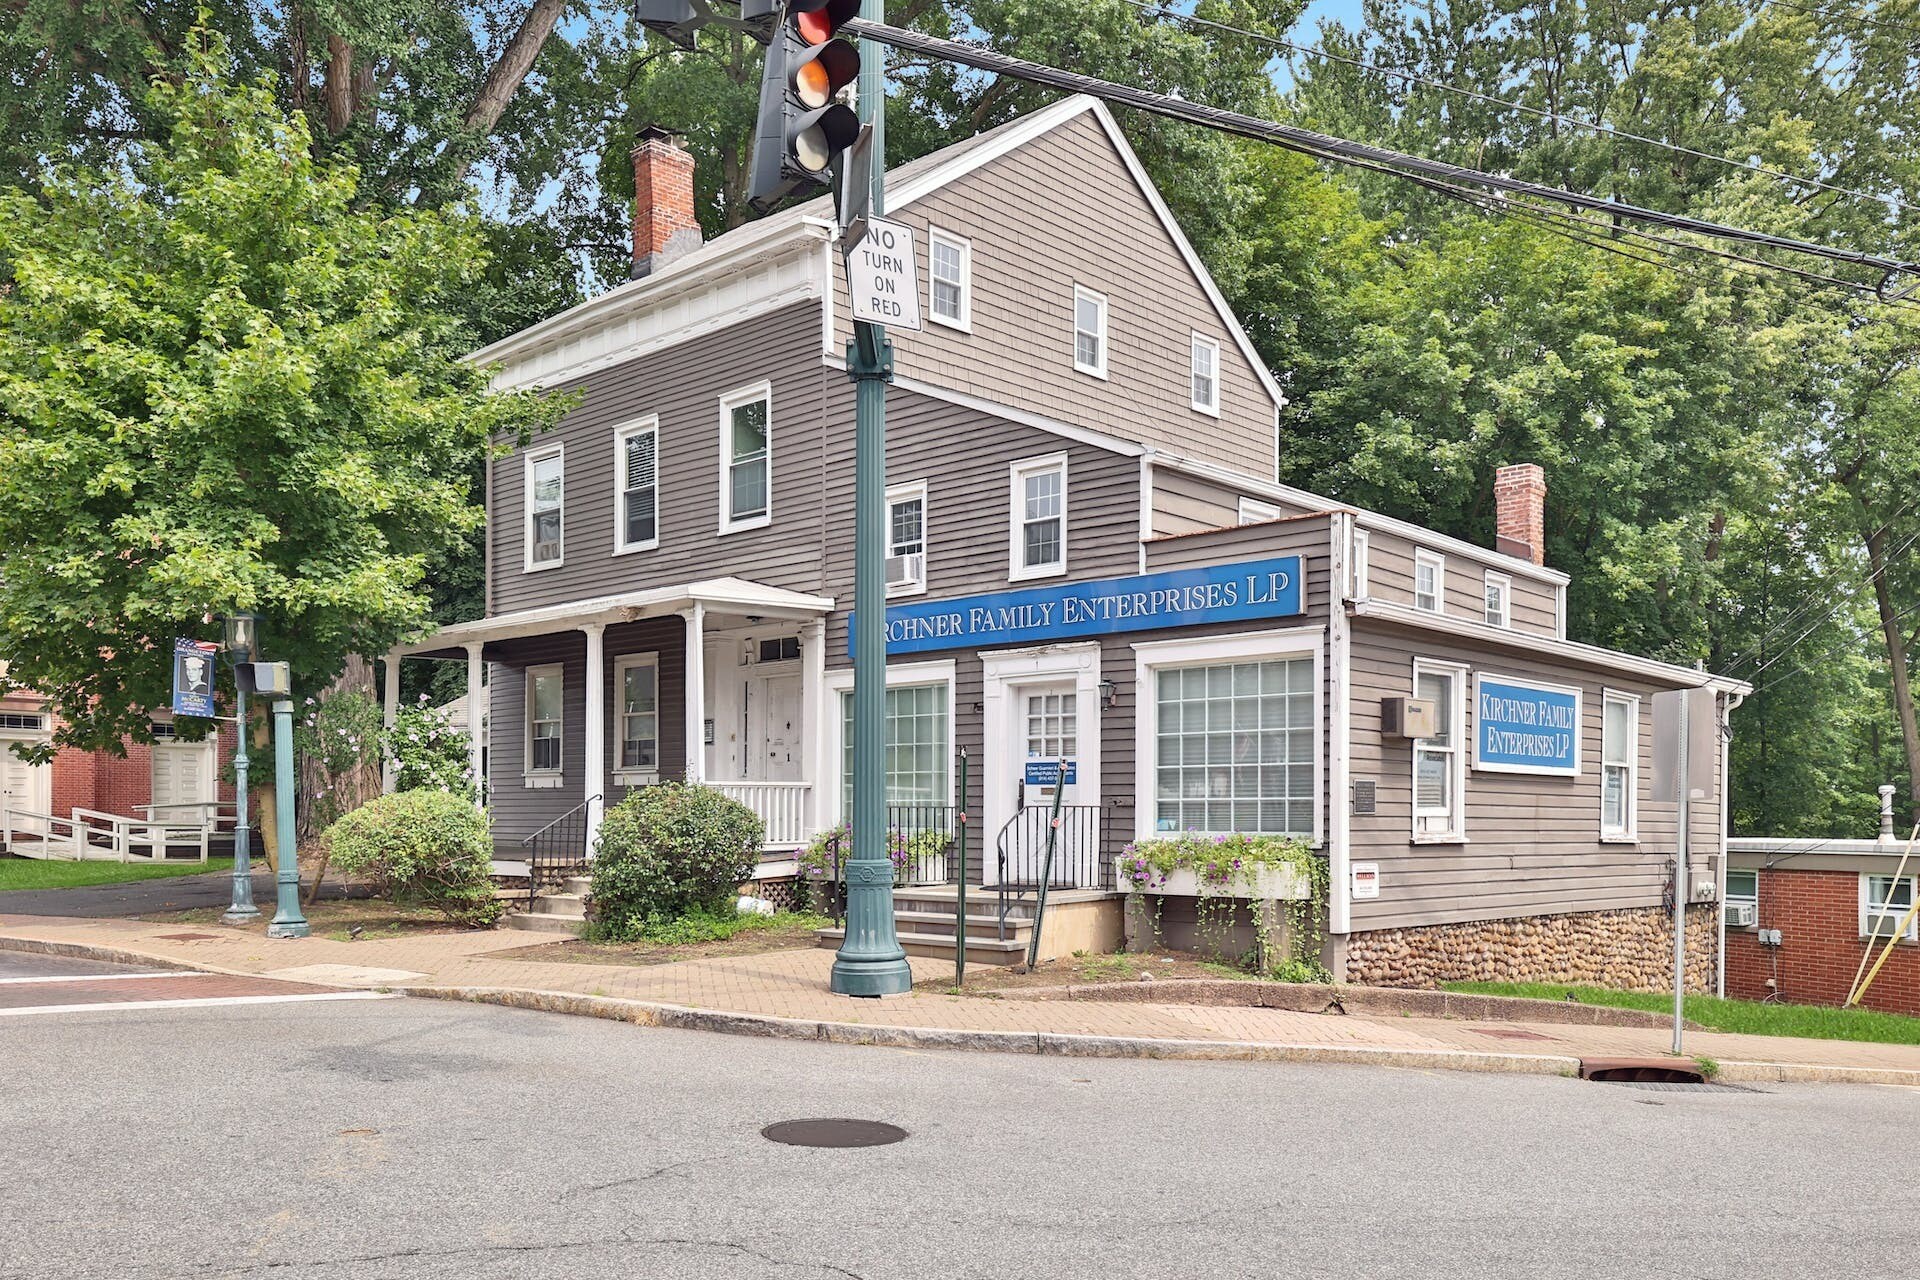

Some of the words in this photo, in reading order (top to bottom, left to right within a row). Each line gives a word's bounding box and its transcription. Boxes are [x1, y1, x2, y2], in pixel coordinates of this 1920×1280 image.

[866, 228, 895, 250] NO
[862, 250, 903, 274] TURN
[875, 276, 896, 294] ON
[872, 297, 901, 317] RED
[883, 613, 964, 642] RCHNER
[969, 602, 1056, 633] FAMILY
[1062, 581, 1238, 624] ENTERPRISES
[1247, 572, 1289, 604] LP
[1481, 693, 1537, 726] KIRCHNER
[1539, 701, 1575, 729] FAMILY
[1487, 726, 1555, 758] ENTERPRISES
[1556, 733, 1570, 758] LP
